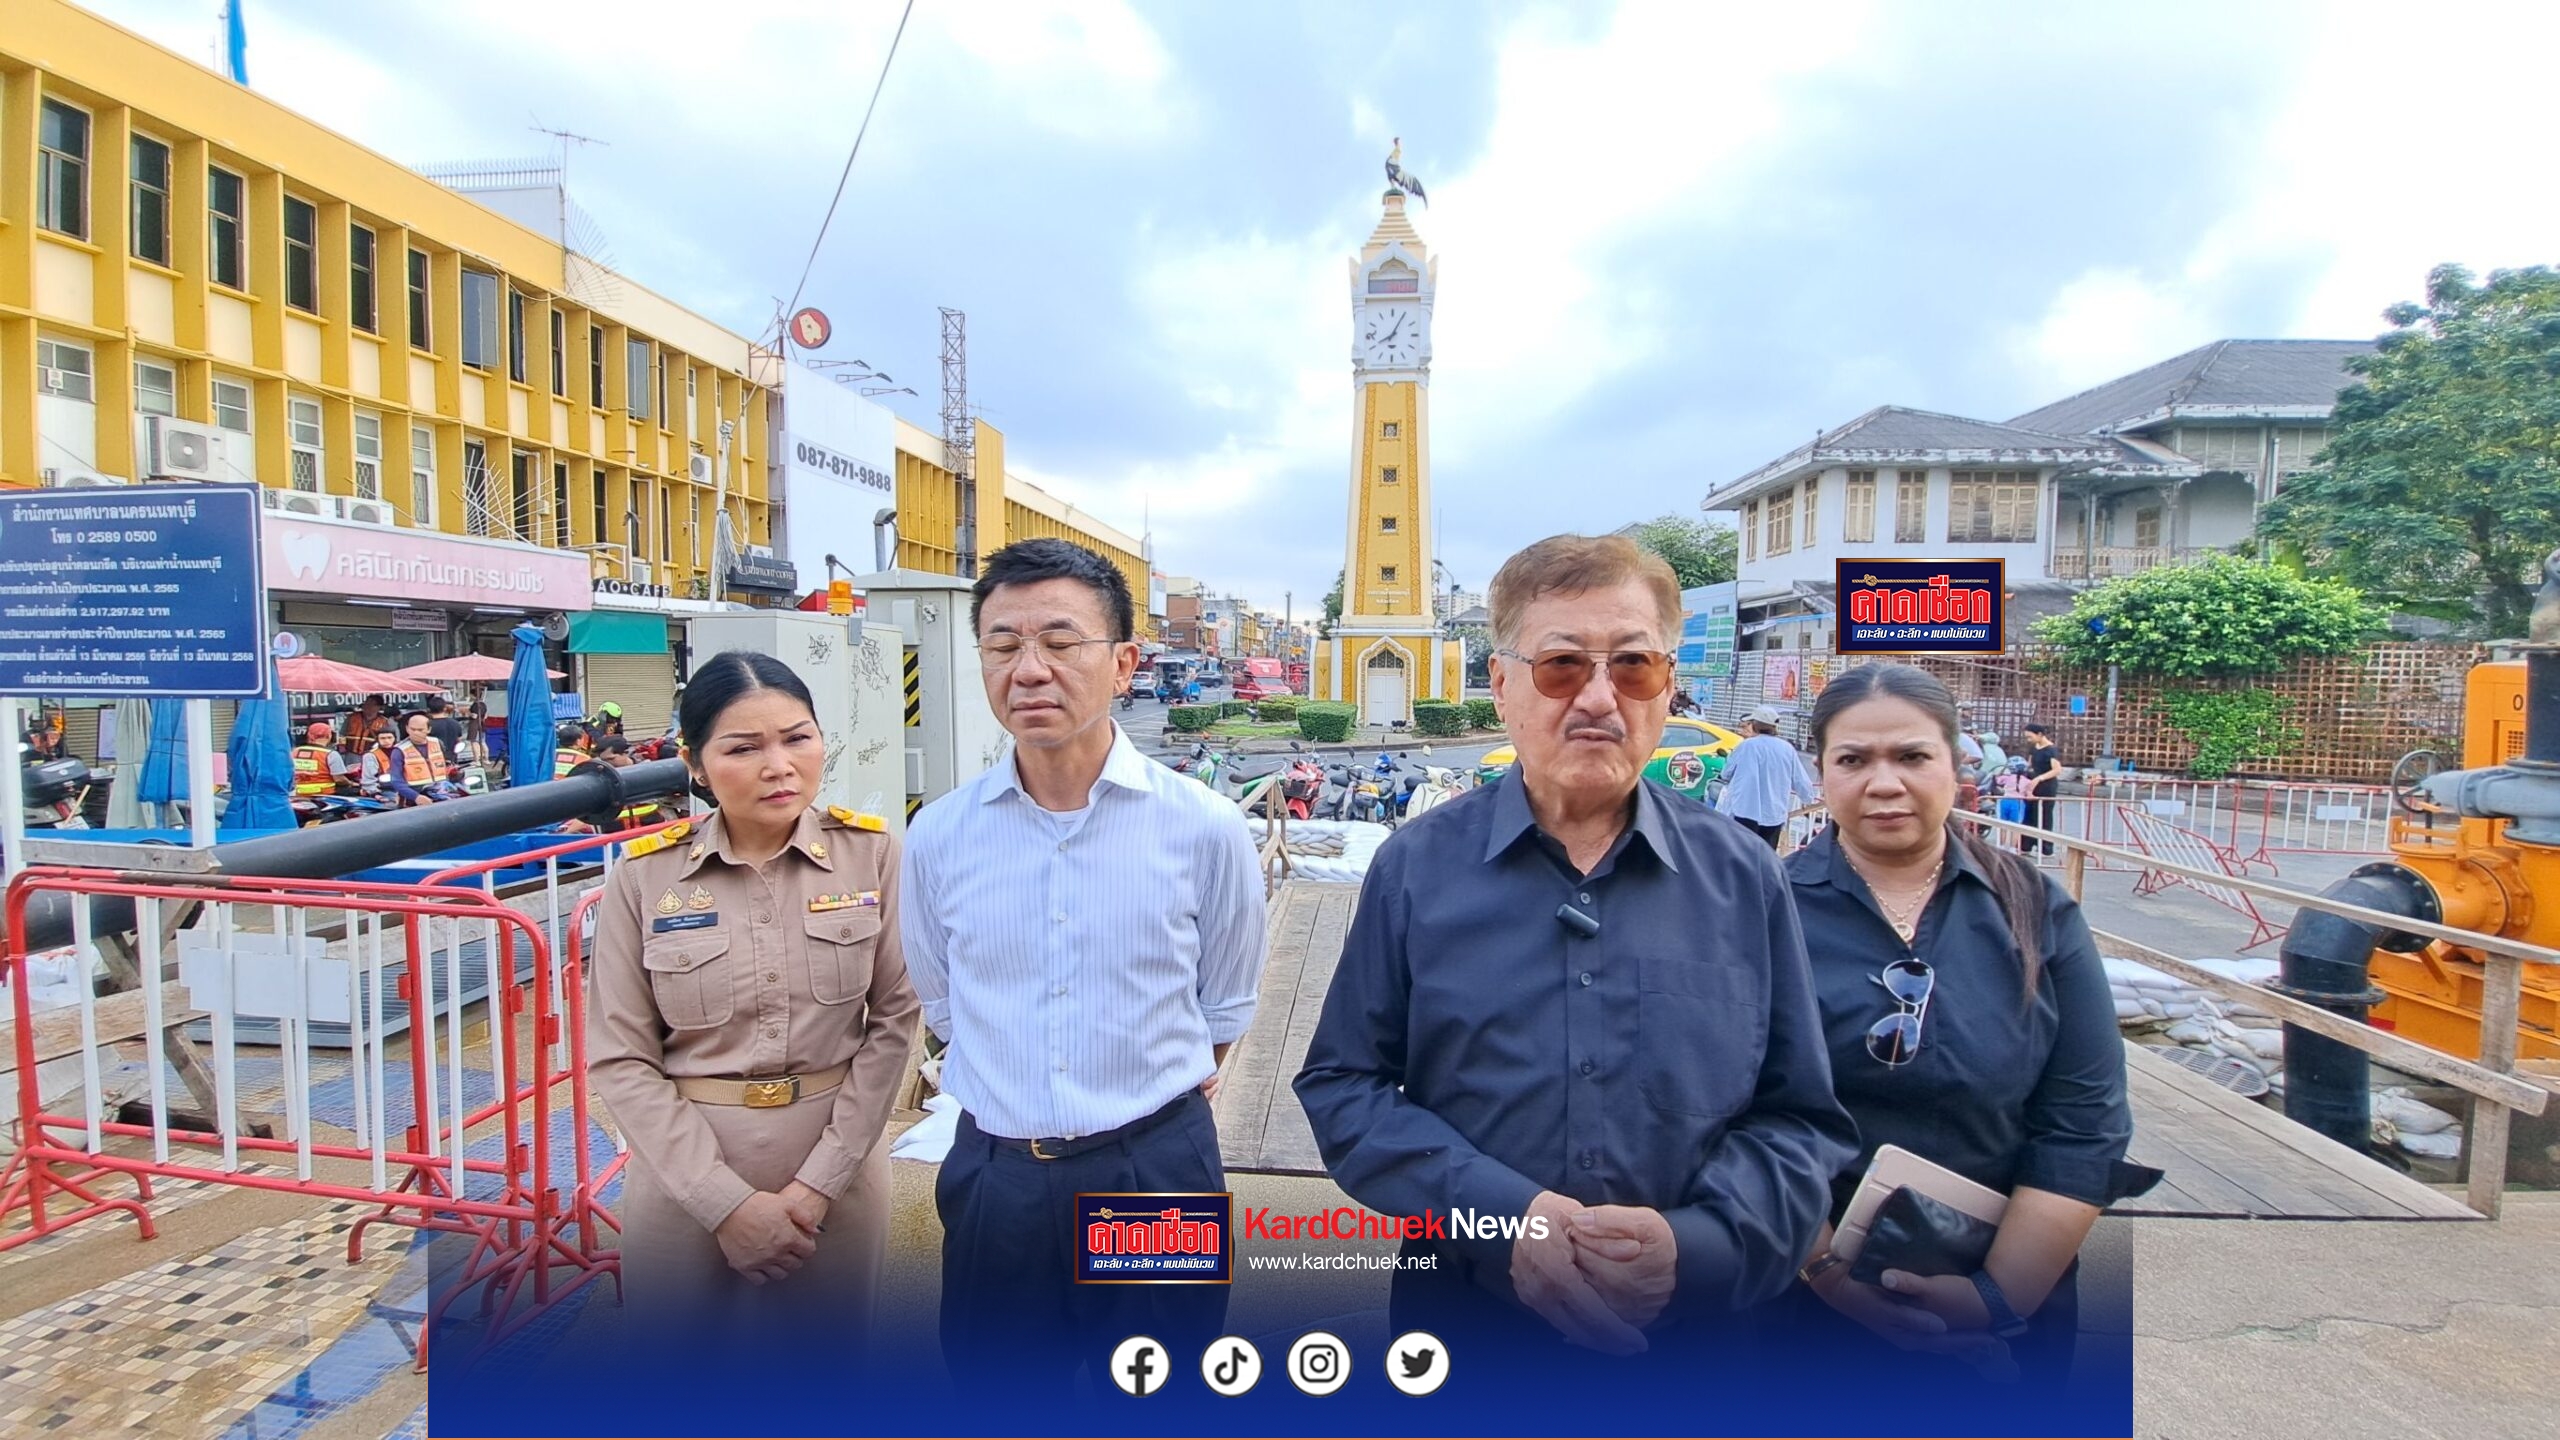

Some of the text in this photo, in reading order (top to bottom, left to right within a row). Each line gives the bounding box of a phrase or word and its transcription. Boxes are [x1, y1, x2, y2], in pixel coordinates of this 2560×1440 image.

[797, 442, 891, 492] 087-871-9888
[13, 499, 196, 525] สำนักงานเทศบาลนครนนทบุรี
[51, 528, 157, 544] โทร 0 2589 0500
